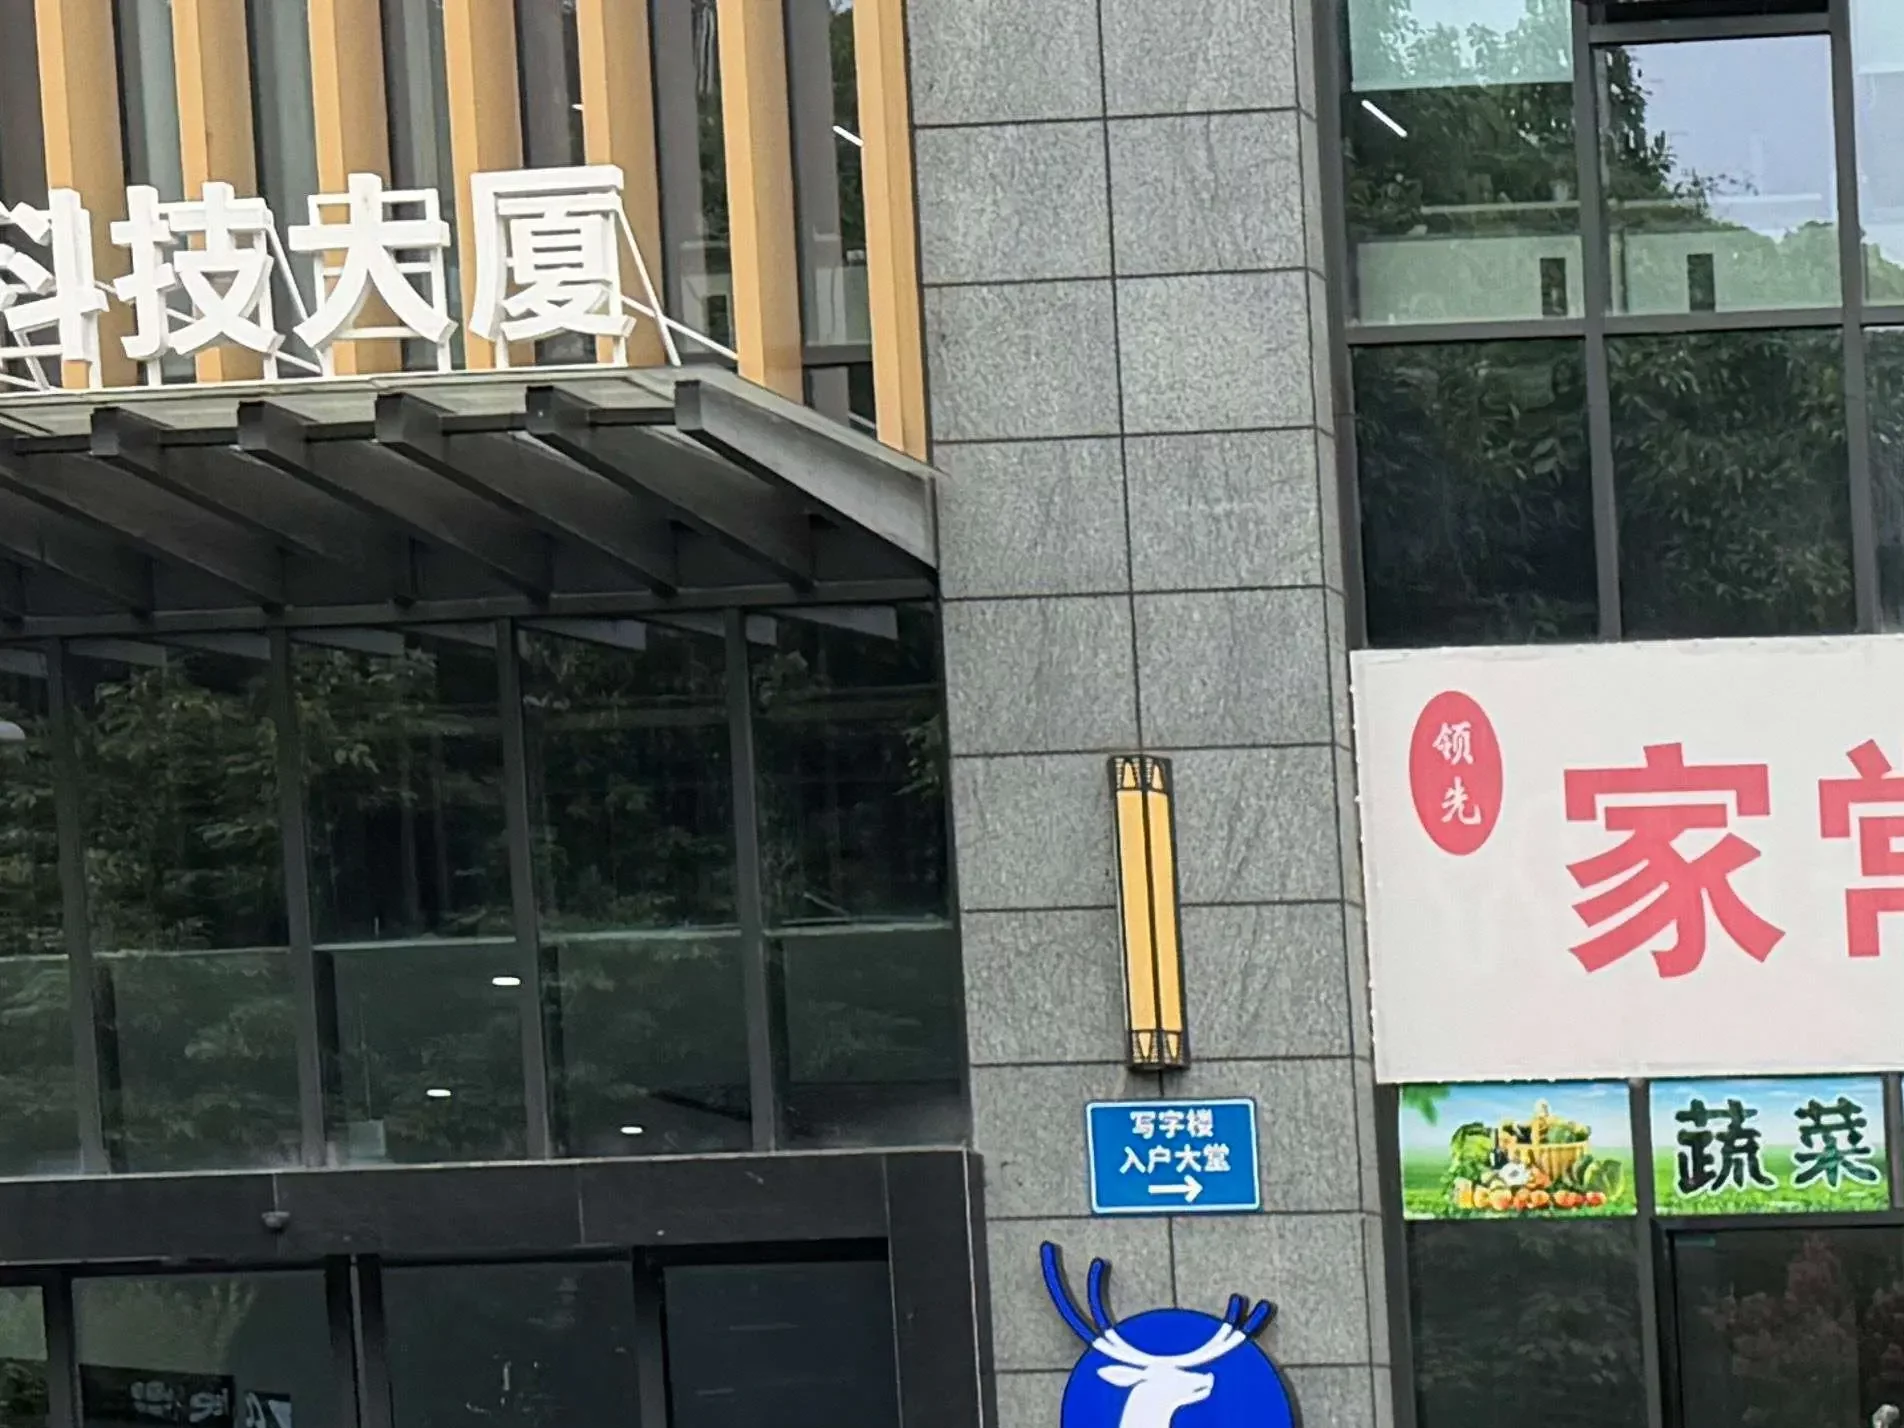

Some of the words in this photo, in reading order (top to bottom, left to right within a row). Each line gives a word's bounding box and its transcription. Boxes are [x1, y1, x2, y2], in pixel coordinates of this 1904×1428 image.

[1432, 720, 1482, 825] 领先
[1130, 1108, 1213, 1139] 写字楼
[1673, 1094, 1879, 1196] 蔬菜
[1119, 1143, 1231, 1174] 入户大堂
